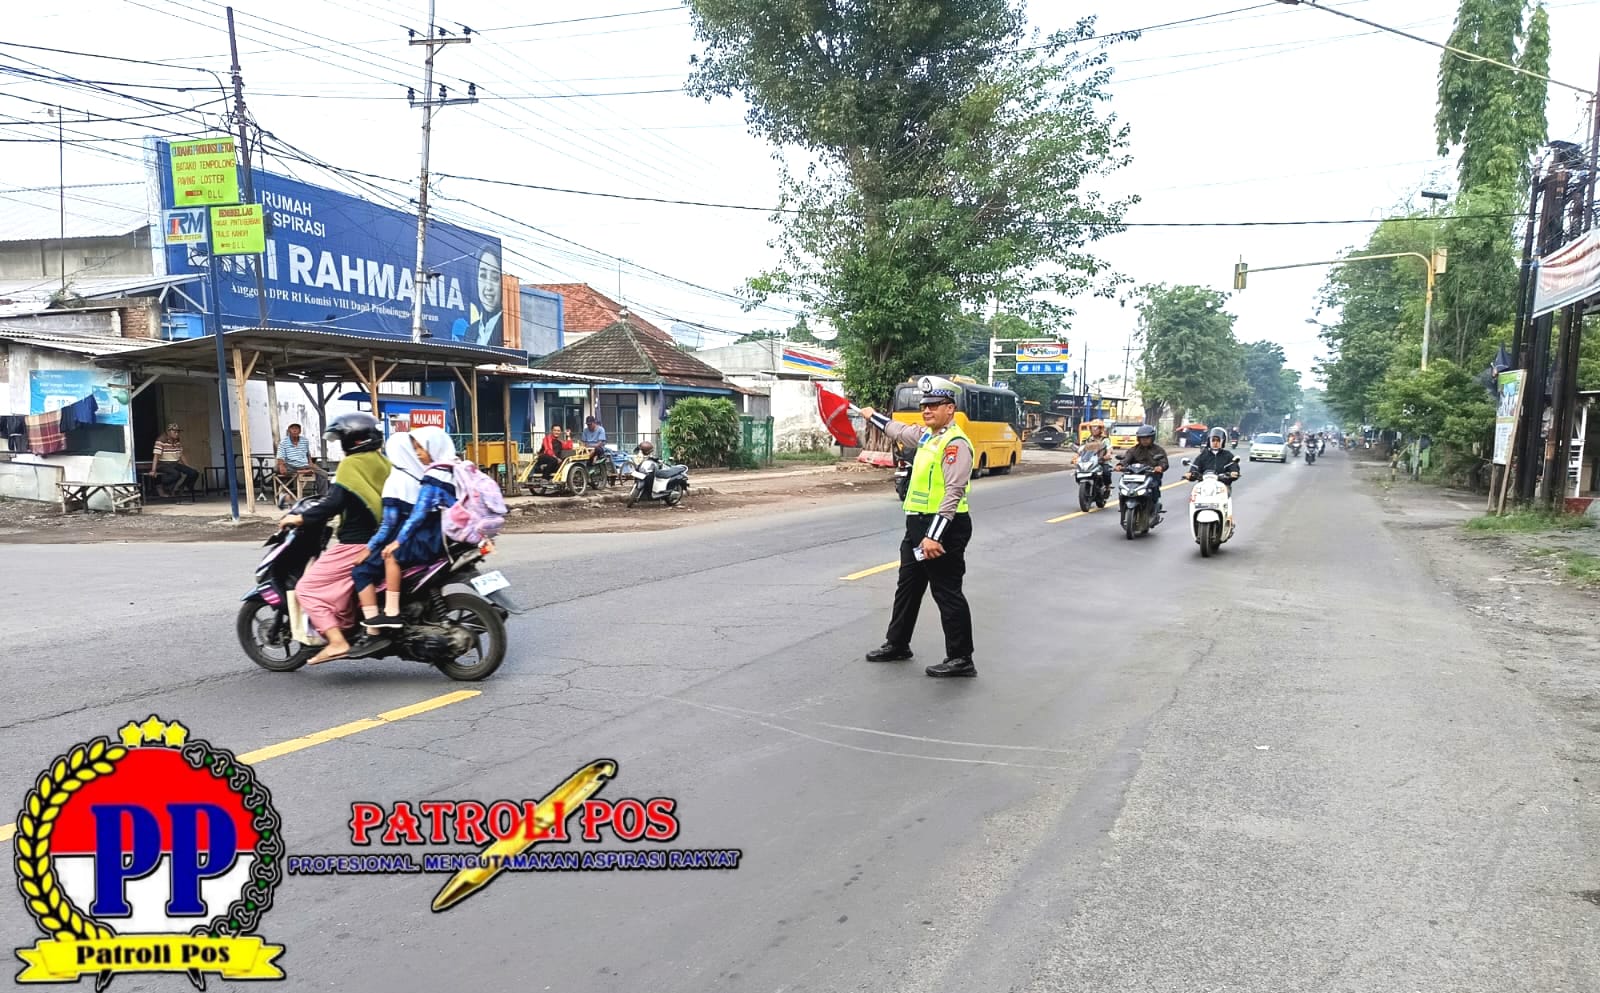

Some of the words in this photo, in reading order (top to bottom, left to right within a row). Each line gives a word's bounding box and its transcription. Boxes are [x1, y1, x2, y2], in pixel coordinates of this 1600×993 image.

[262, 191, 312, 217] RUMAH
[264, 209, 325, 238] SPIRASI
[288, 243, 465, 311] RAHMANIA
[269, 287, 290, 301] DPR
[291, 290, 302, 303] RI
[303, 293, 332, 308] Komisi
[333, 298, 349, 308] VIII
[413, 413, 442, 425] MALANG
